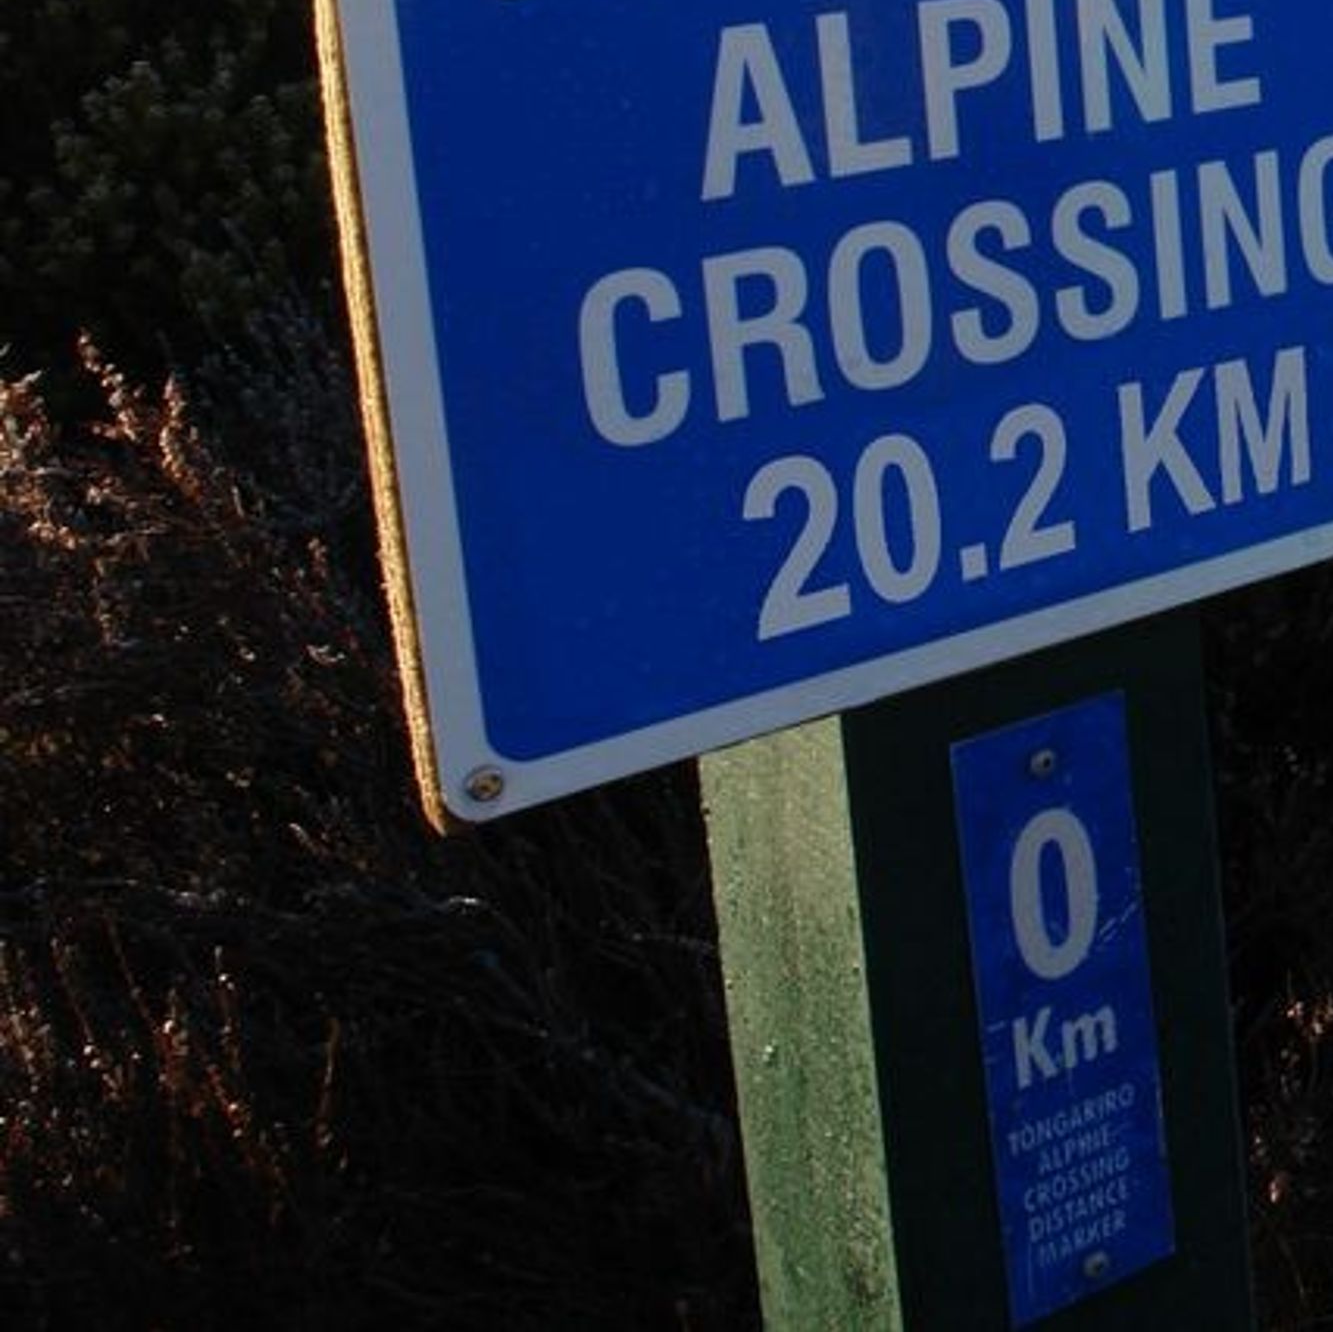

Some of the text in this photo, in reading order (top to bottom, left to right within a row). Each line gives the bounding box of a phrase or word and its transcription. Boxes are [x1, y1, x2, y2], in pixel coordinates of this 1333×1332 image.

[741, 346, 1312, 642] 20.2 KM
[1010, 808, 1098, 980] 0
[1012, 1002, 1118, 1089] Km
[1008, 1083, 1136, 1157] TONGARIRO
[1024, 1146, 1130, 1212] CROSSING
[1029, 1176, 1128, 1243] DISTANCE
[1038, 1209, 1126, 1267] MARKER
